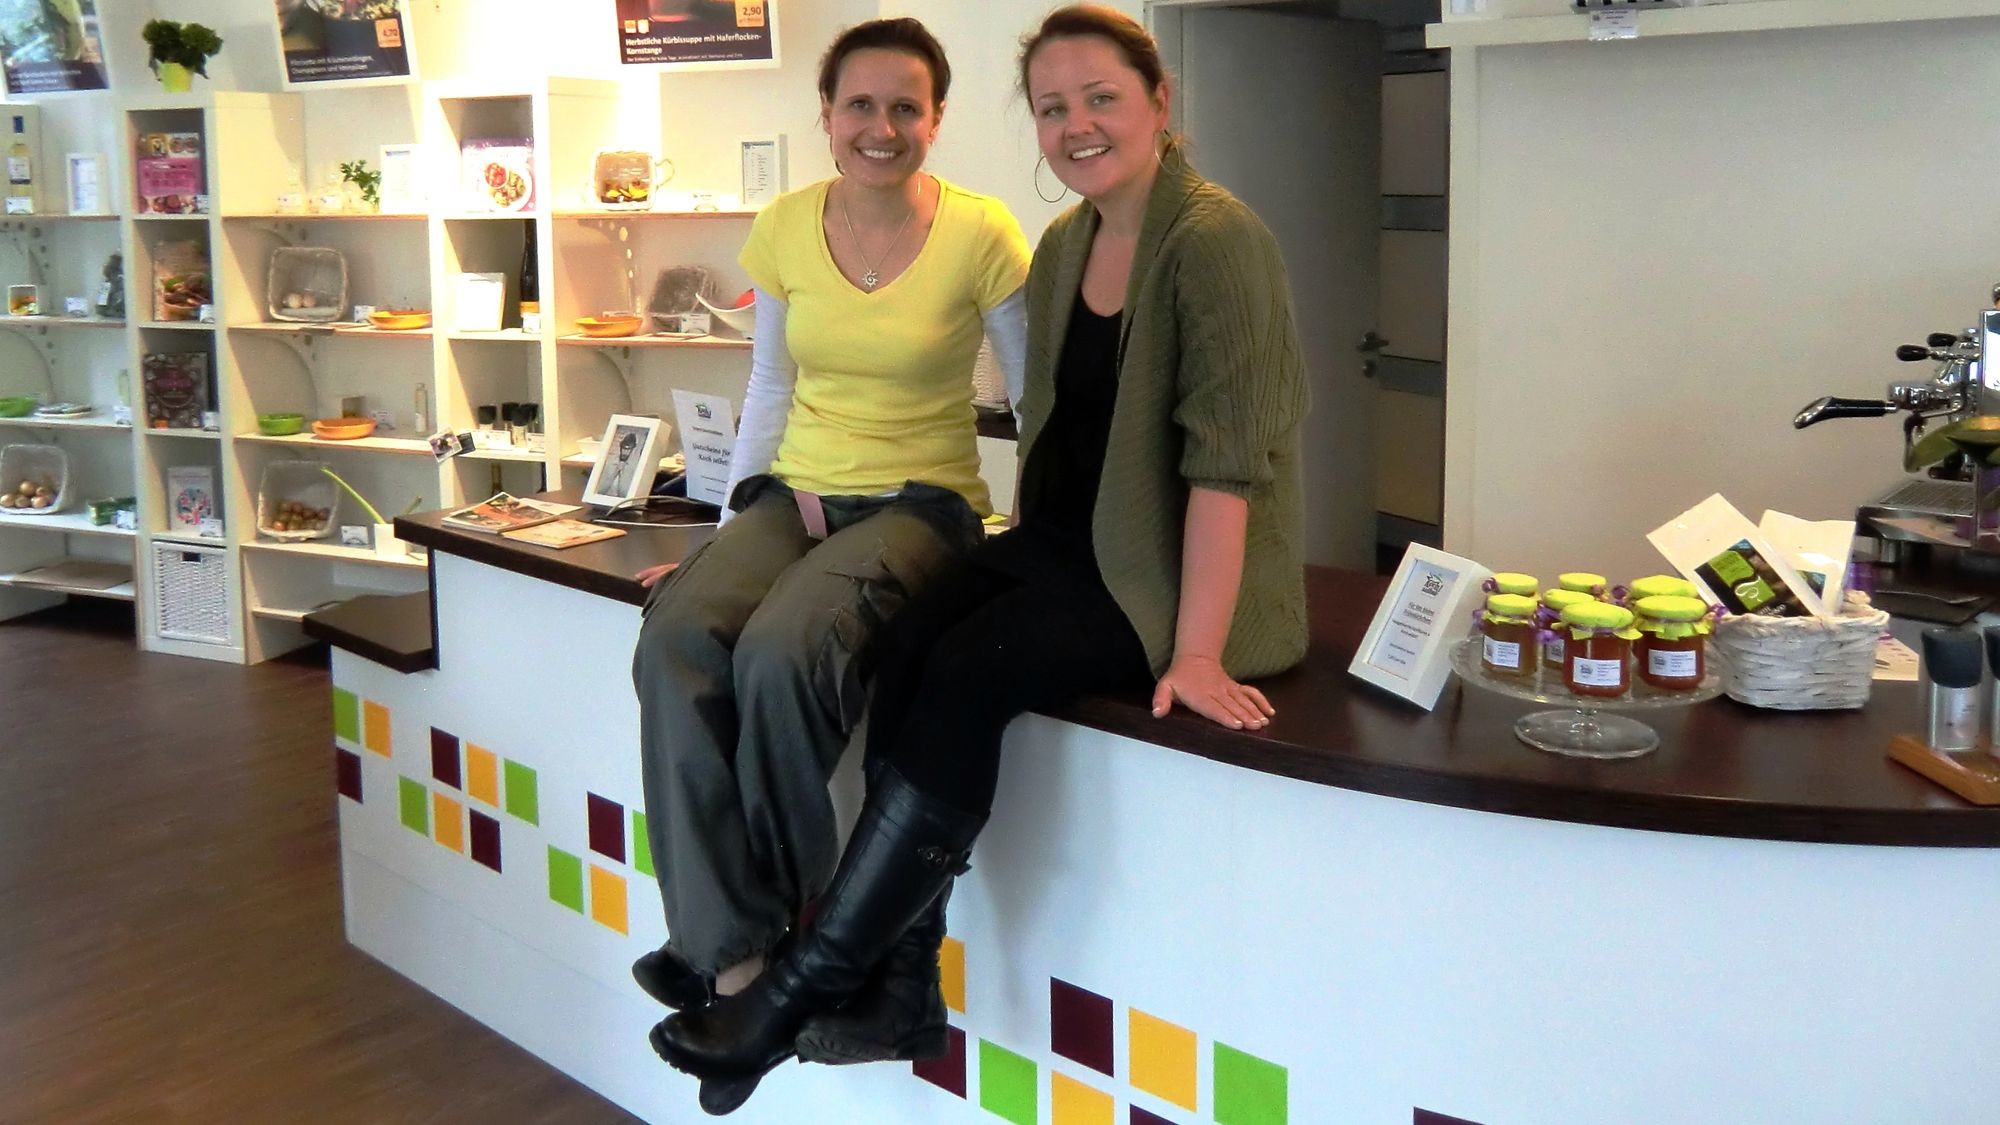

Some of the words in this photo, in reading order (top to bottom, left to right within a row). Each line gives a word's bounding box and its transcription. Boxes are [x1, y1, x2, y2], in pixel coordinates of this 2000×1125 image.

[742, 6, 762, 17] 2,90
[625, 37, 662, 46] Herbstliche
[662, 35, 703, 45] Kürbissuppe
[703, 34, 716, 43] mit
[716, 32, 762, 42] Haferflocken-
[626, 47, 663, 56] Kornstange
